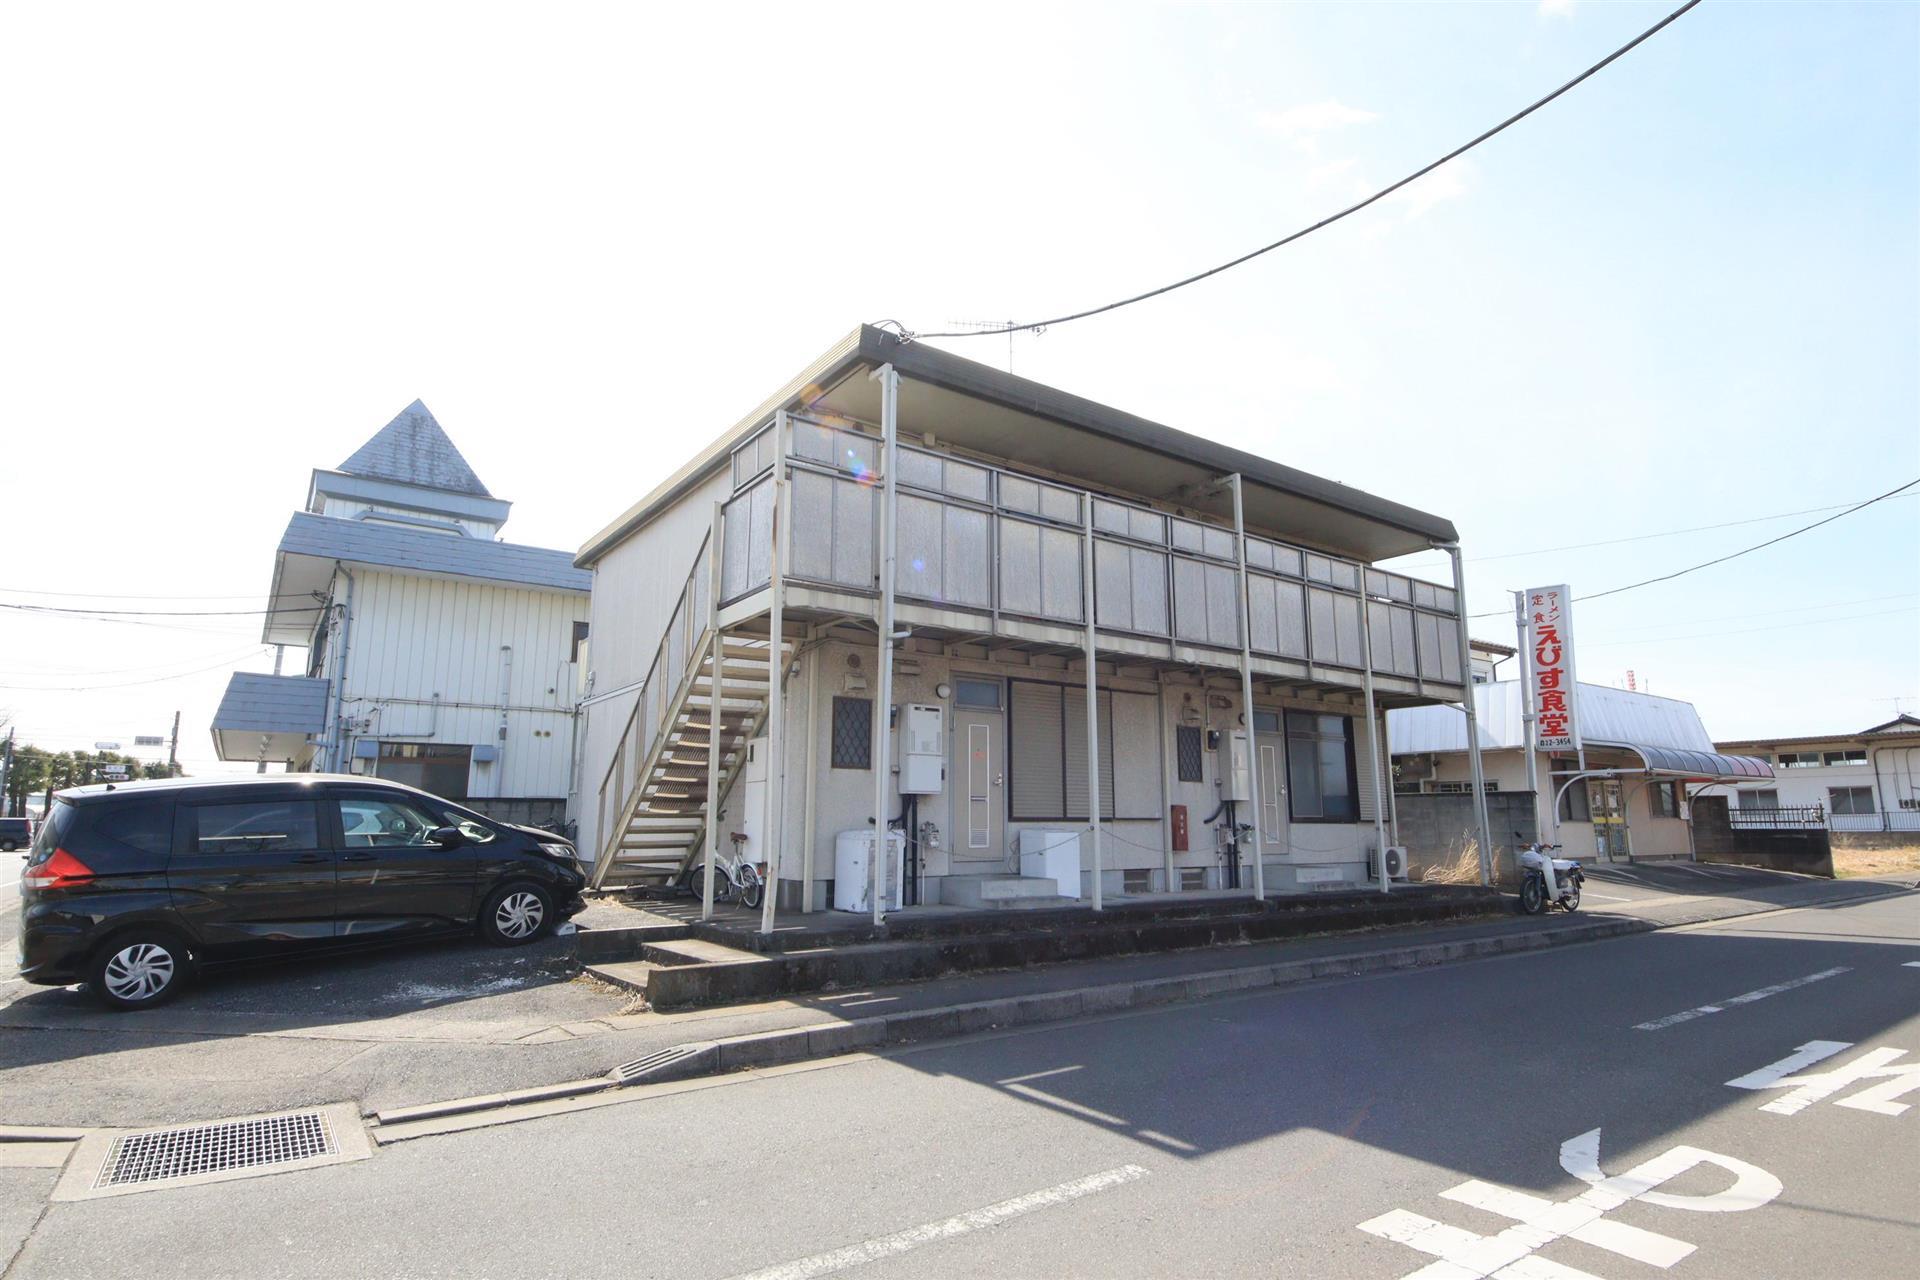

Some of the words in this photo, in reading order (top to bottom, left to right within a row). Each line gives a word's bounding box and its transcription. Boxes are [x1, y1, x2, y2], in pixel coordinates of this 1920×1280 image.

[1532, 594, 1545, 624] 定食
[1547, 591, 1560, 622] ラーメン
[1536, 625, 1569, 737] えびす食堂
